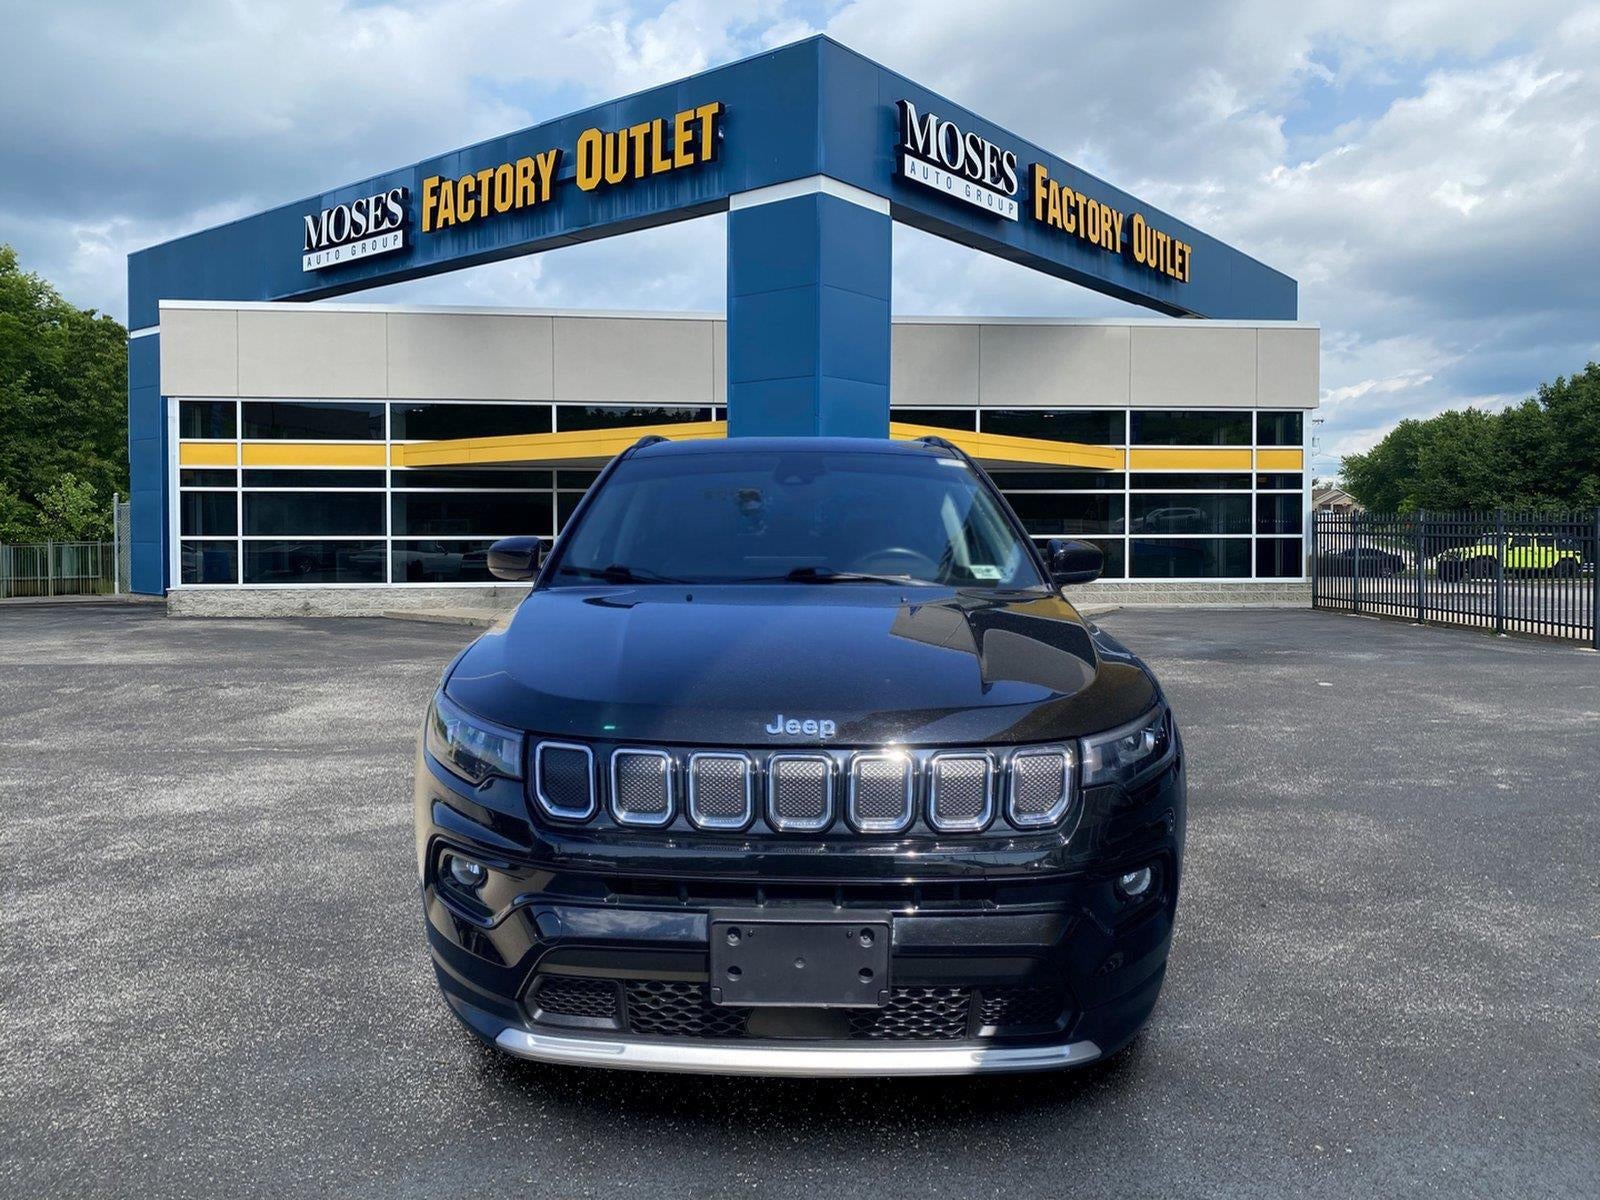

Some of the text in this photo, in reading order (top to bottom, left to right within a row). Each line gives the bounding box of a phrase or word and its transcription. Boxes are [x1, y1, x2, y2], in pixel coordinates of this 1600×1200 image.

[421, 102, 721, 233] FACTORY OUTLET
[904, 100, 1018, 195] MOSES
[908, 160, 1015, 214] AUTO GROUP
[303, 188, 404, 251] MOSES
[306, 234, 400, 267] AUTO GROUP
[1033, 163, 1192, 283] FACTORY OUTLET
[766, 714, 836, 739] Jeep
